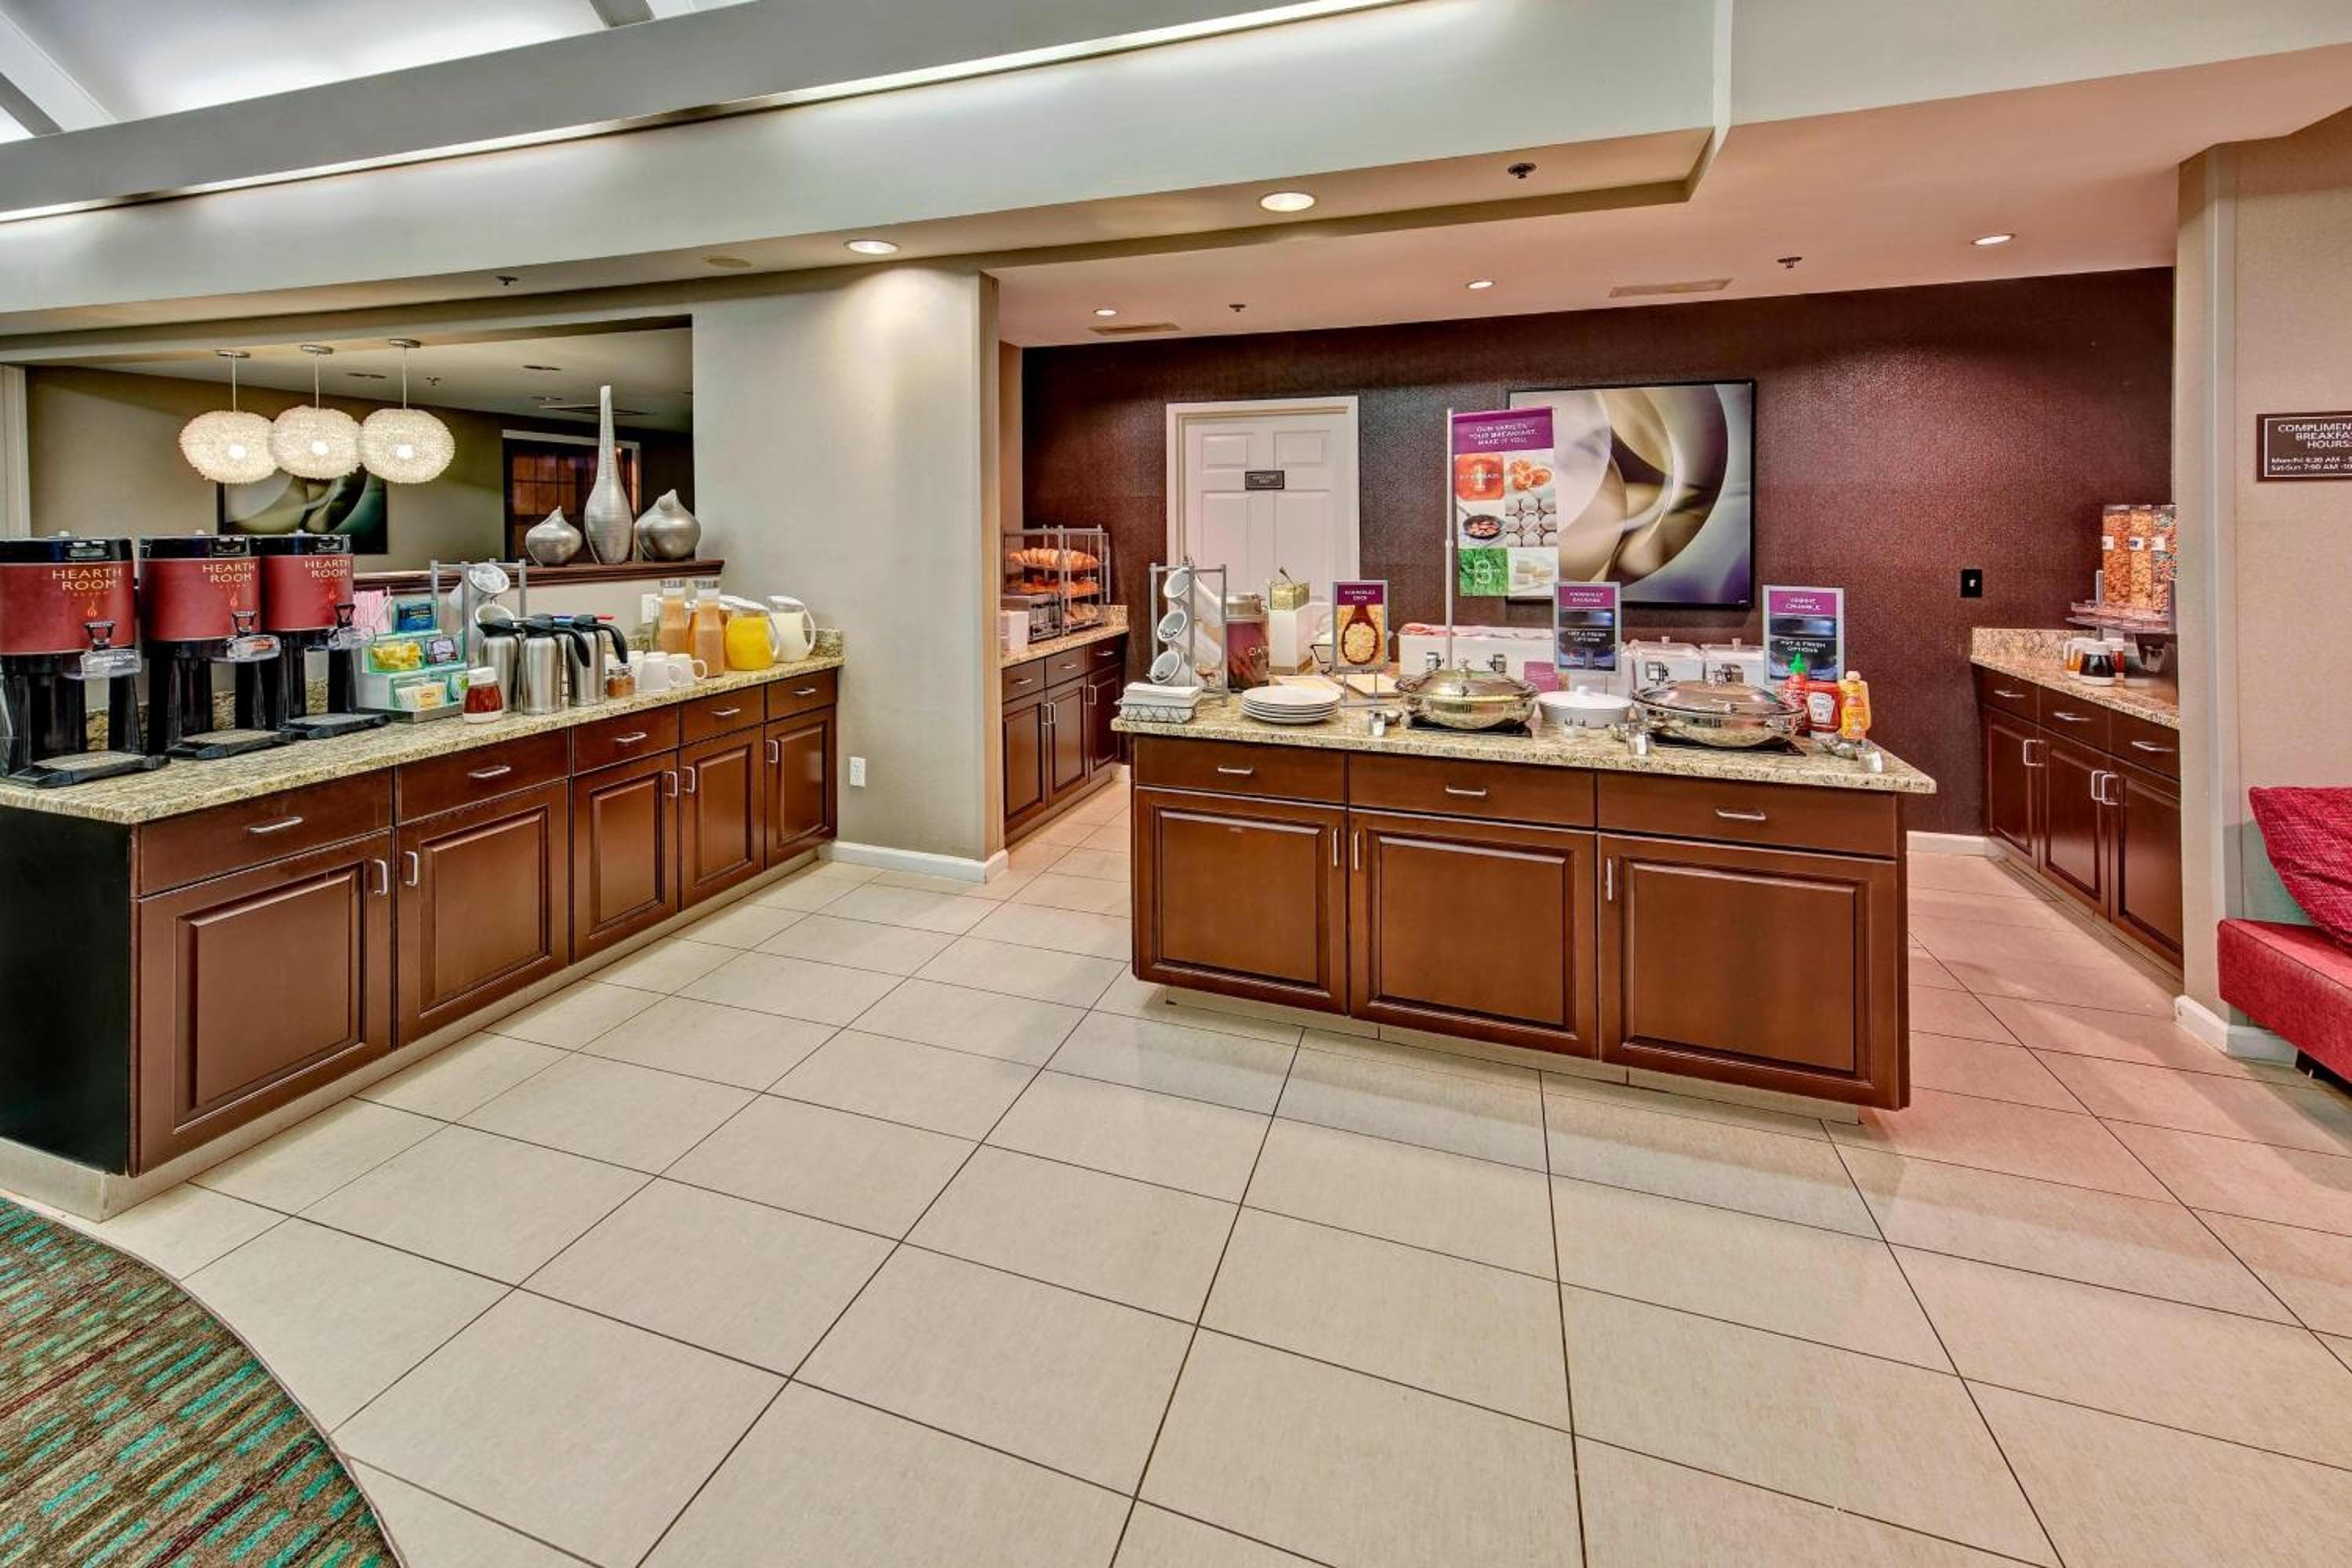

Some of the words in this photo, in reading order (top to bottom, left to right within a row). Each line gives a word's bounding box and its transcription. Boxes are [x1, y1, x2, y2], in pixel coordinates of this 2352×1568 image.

[2278, 423, 2352, 433] COMPLIMEN
[202, 562, 256, 573] HEARTH
[303, 559, 350, 569] HEARTH
[52, 567, 122, 579] HEARTH
[210, 573, 252, 583] ROOM
[311, 568, 347, 579] ROOM
[62, 579, 116, 590] ROOM
